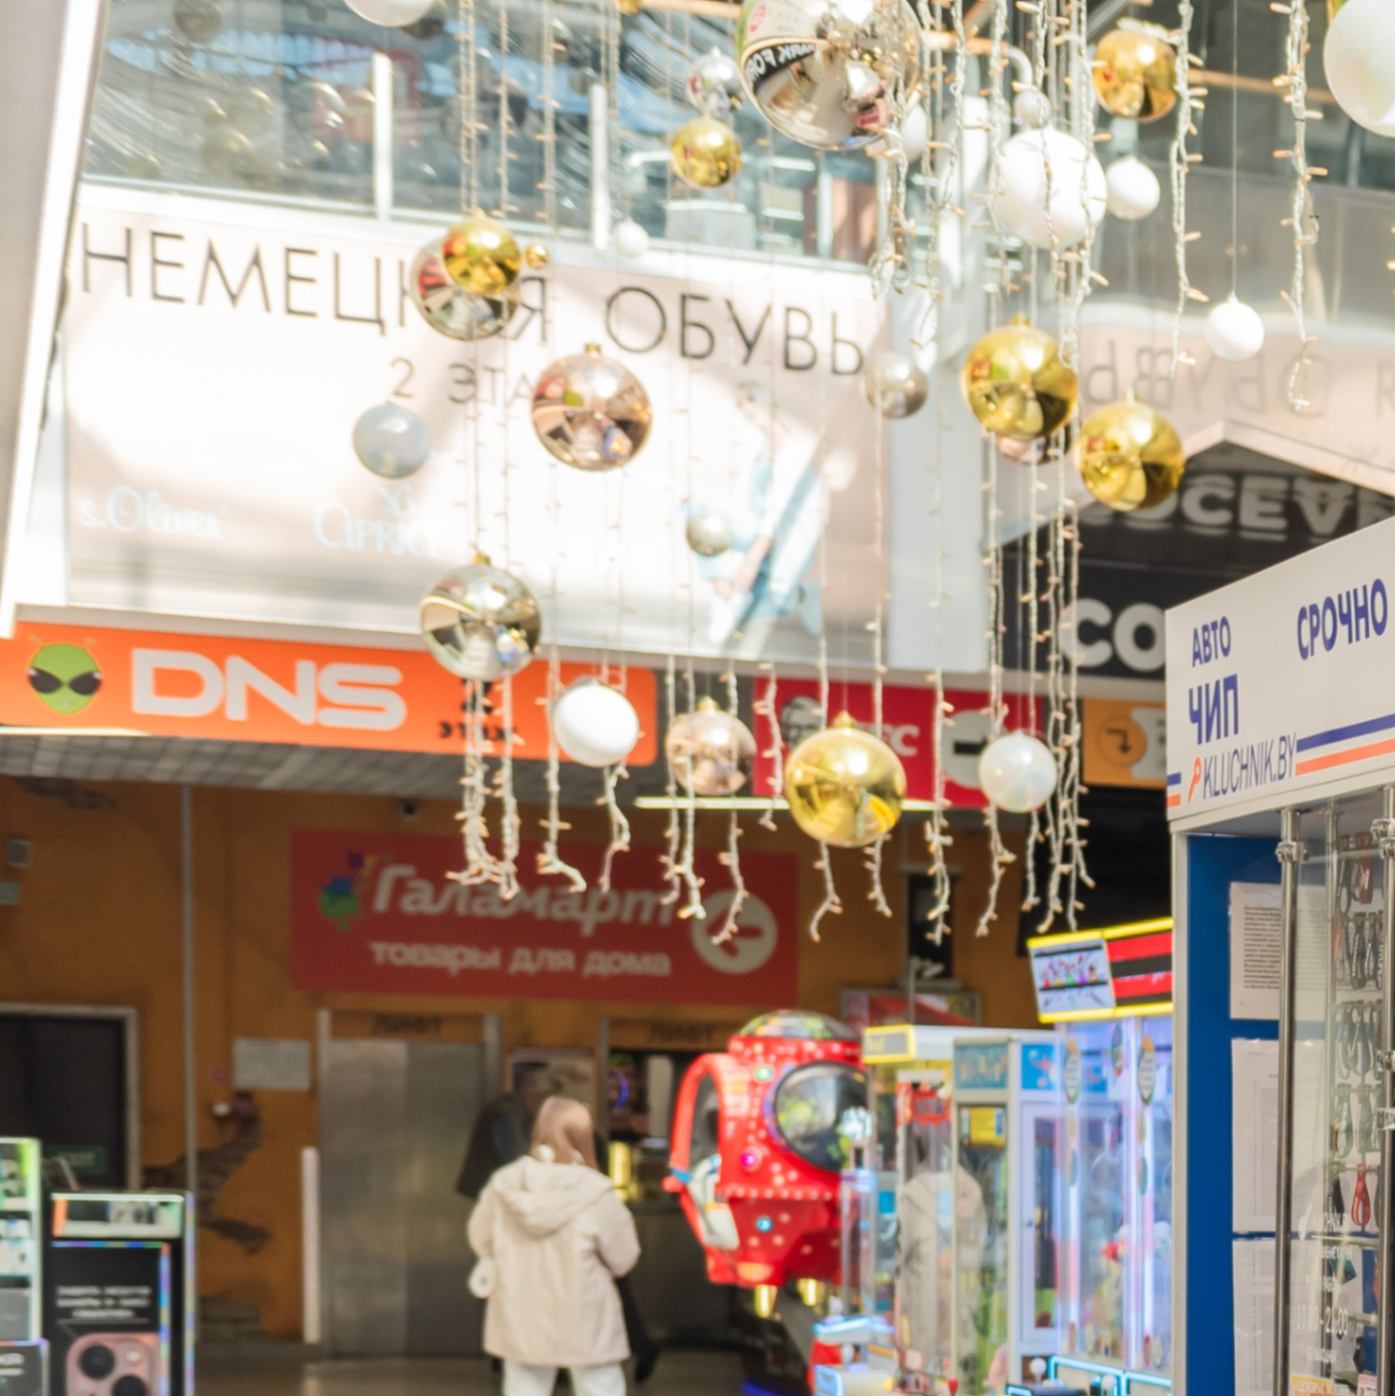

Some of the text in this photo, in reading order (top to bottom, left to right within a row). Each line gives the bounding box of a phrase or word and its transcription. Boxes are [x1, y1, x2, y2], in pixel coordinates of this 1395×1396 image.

[82, 222, 866, 376] НЕМЕЦЯ ОБУВЬ
[391, 357, 536, 405] 2 ЭТА
[1191, 615, 1232, 669] АВТО
[1297, 578, 1388, 660] СРОЧНО
[130, 648, 407, 731] DNS
[1189, 673, 1240, 746] ЧИП
[1203, 730, 1297, 801] KLUCHNIK.BY
[371, 864, 680, 936] Галамарт
[369, 940, 672, 978] товары для дома
